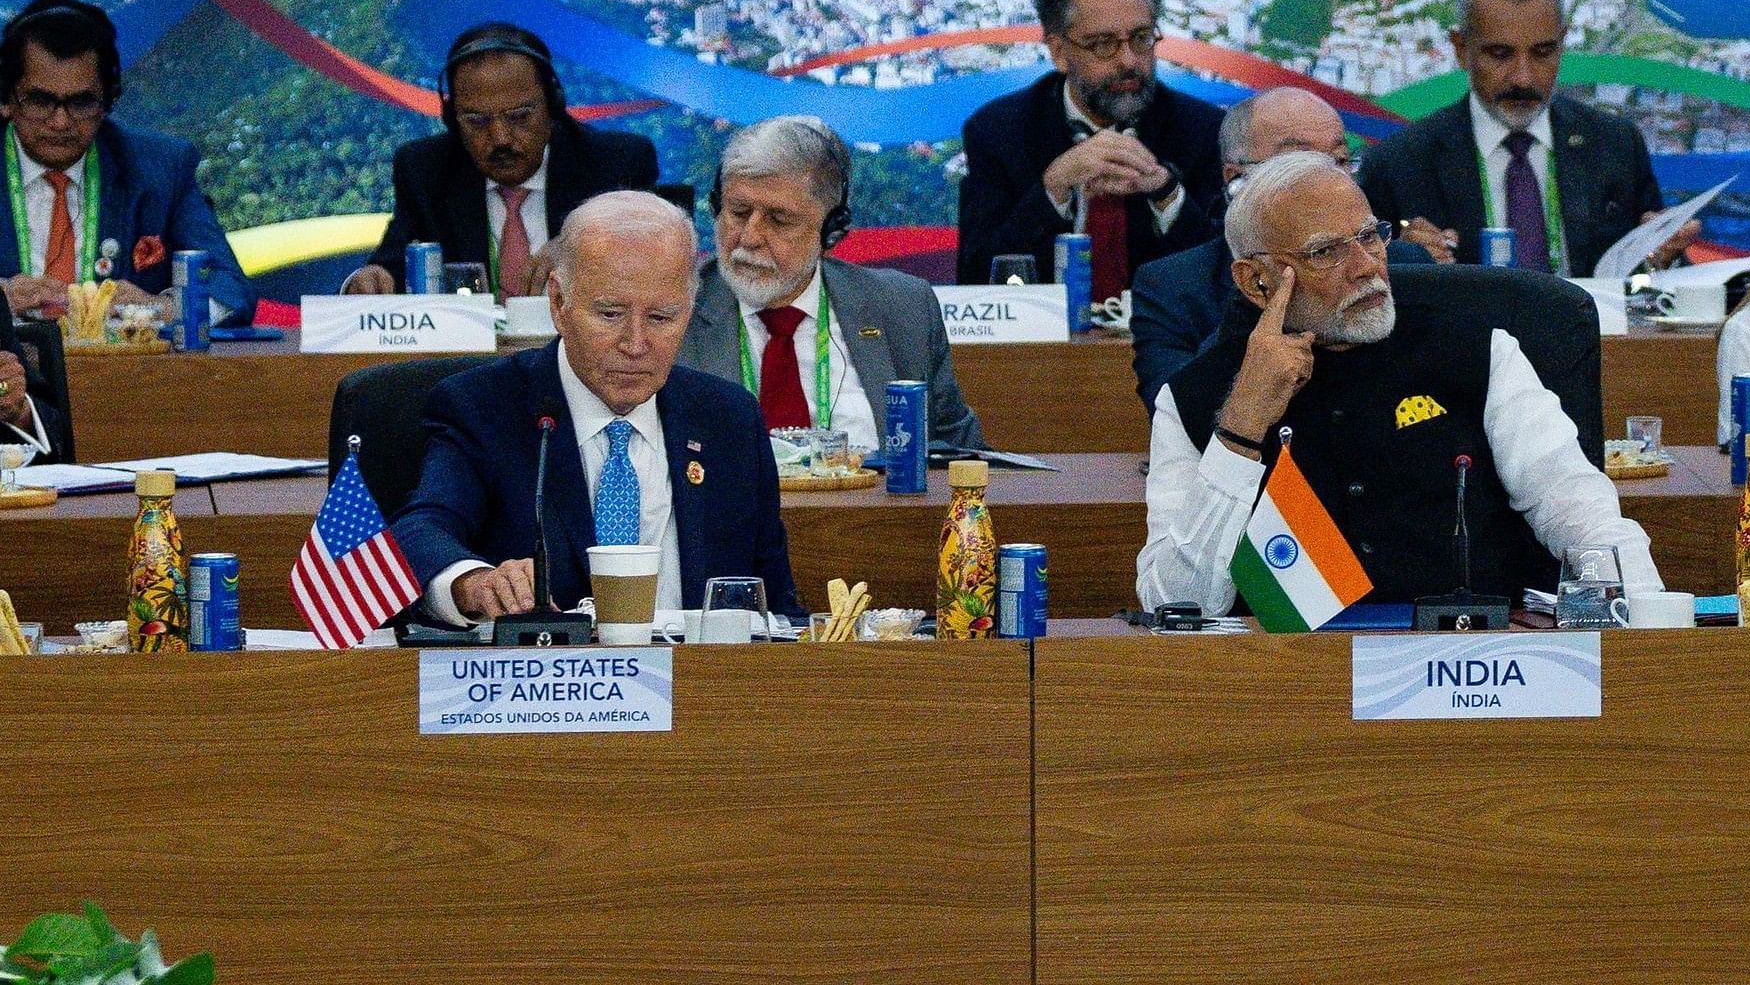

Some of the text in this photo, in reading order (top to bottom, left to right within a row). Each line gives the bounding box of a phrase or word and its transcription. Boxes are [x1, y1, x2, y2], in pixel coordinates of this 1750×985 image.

[943, 303, 1017, 321] RAZIL
[359, 313, 435, 331] INDIA
[950, 325, 995, 337] BRASIL
[379, 333, 418, 346] ÍNDIA
[452, 658, 641, 680] UNITED STATES
[1427, 660, 1526, 687] INDIA
[467, 681, 625, 703] OF AMERICA
[1451, 691, 1502, 709] ÍNDIA
[440, 708, 651, 727] ESTADOS UNIDOS DA AMÉRICA
